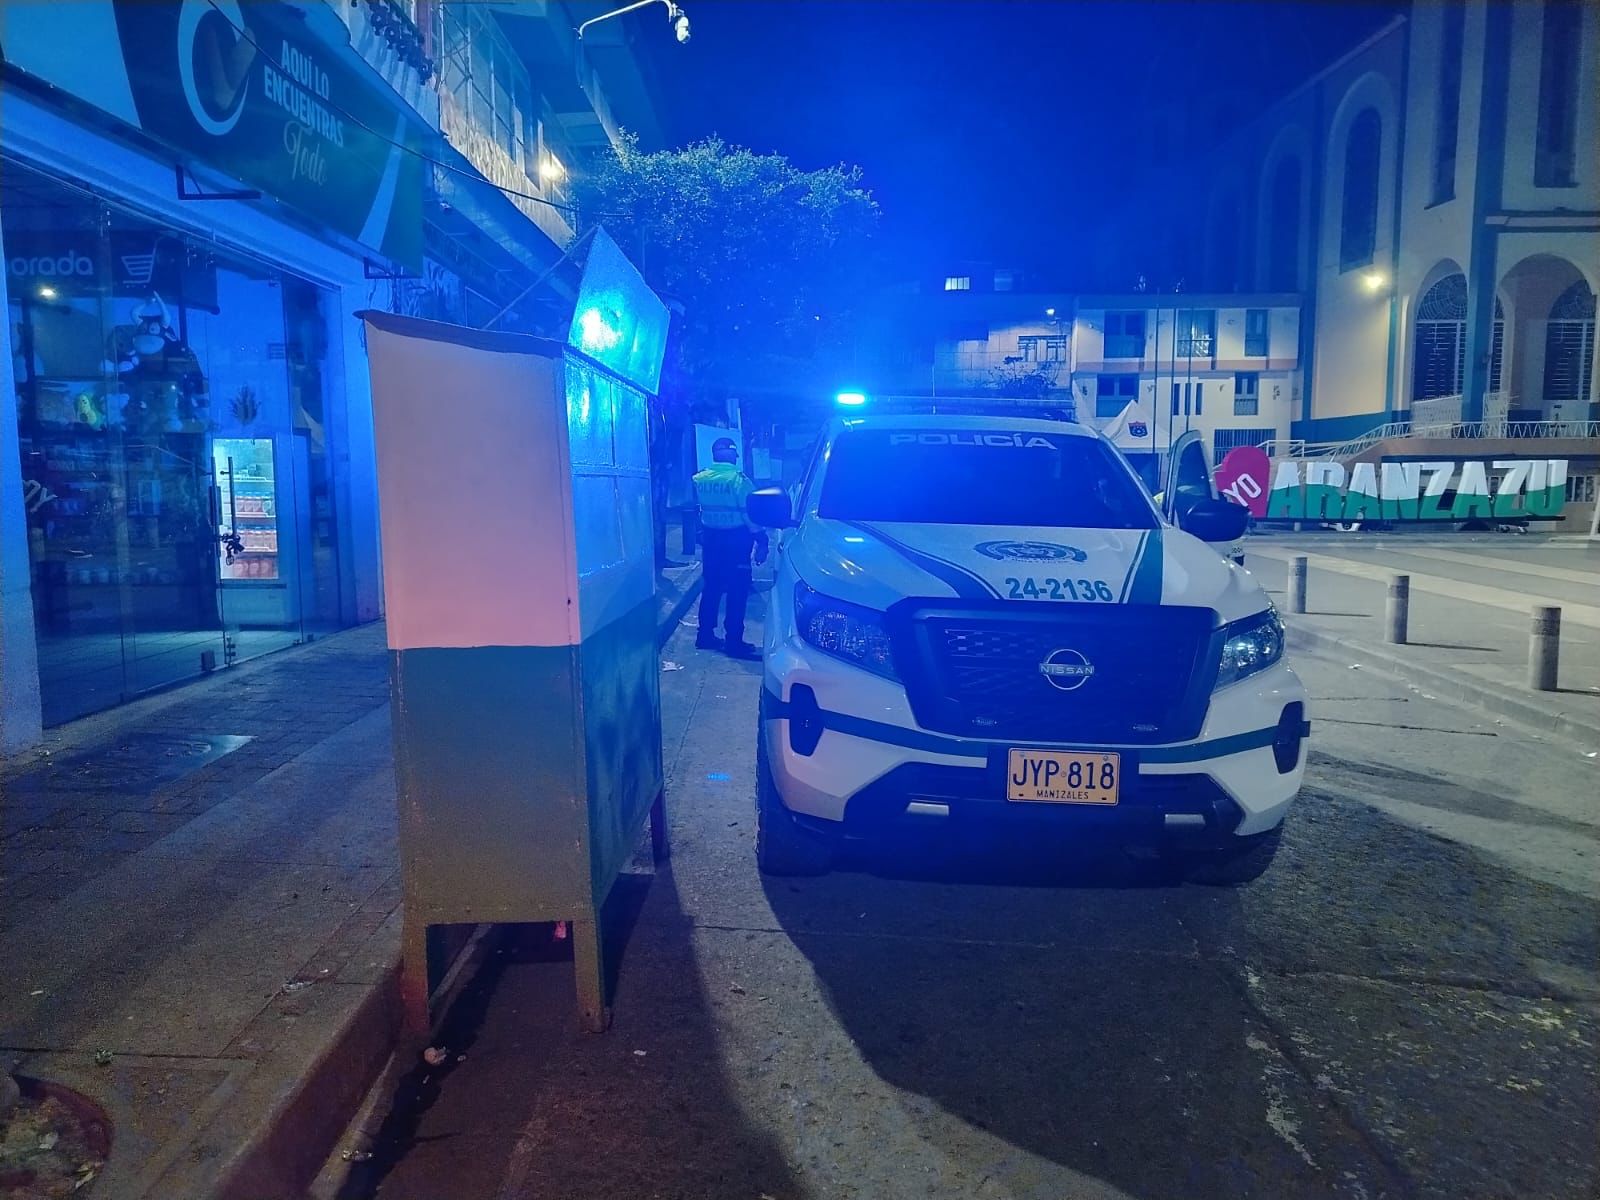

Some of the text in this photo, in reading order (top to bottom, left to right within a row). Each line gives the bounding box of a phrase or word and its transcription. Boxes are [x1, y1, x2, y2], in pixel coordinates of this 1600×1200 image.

[315, 65, 330, 101] LO
[264, 64, 344, 148] ENCUENTRAS
[284, 120, 328, 186] Todo
[5, 249, 94, 276] orada
[889, 433, 1058, 450] POLICÍA
[1222, 472, 1263, 508] YO
[1267, 459, 1569, 519] ARANZAZU
[1005, 577, 1114, 602] 24-2136
[1040, 664, 1094, 675] NISSAN
[1012, 758, 1115, 790] JYP 818
[1036, 789, 1089, 800] MANIZALES
